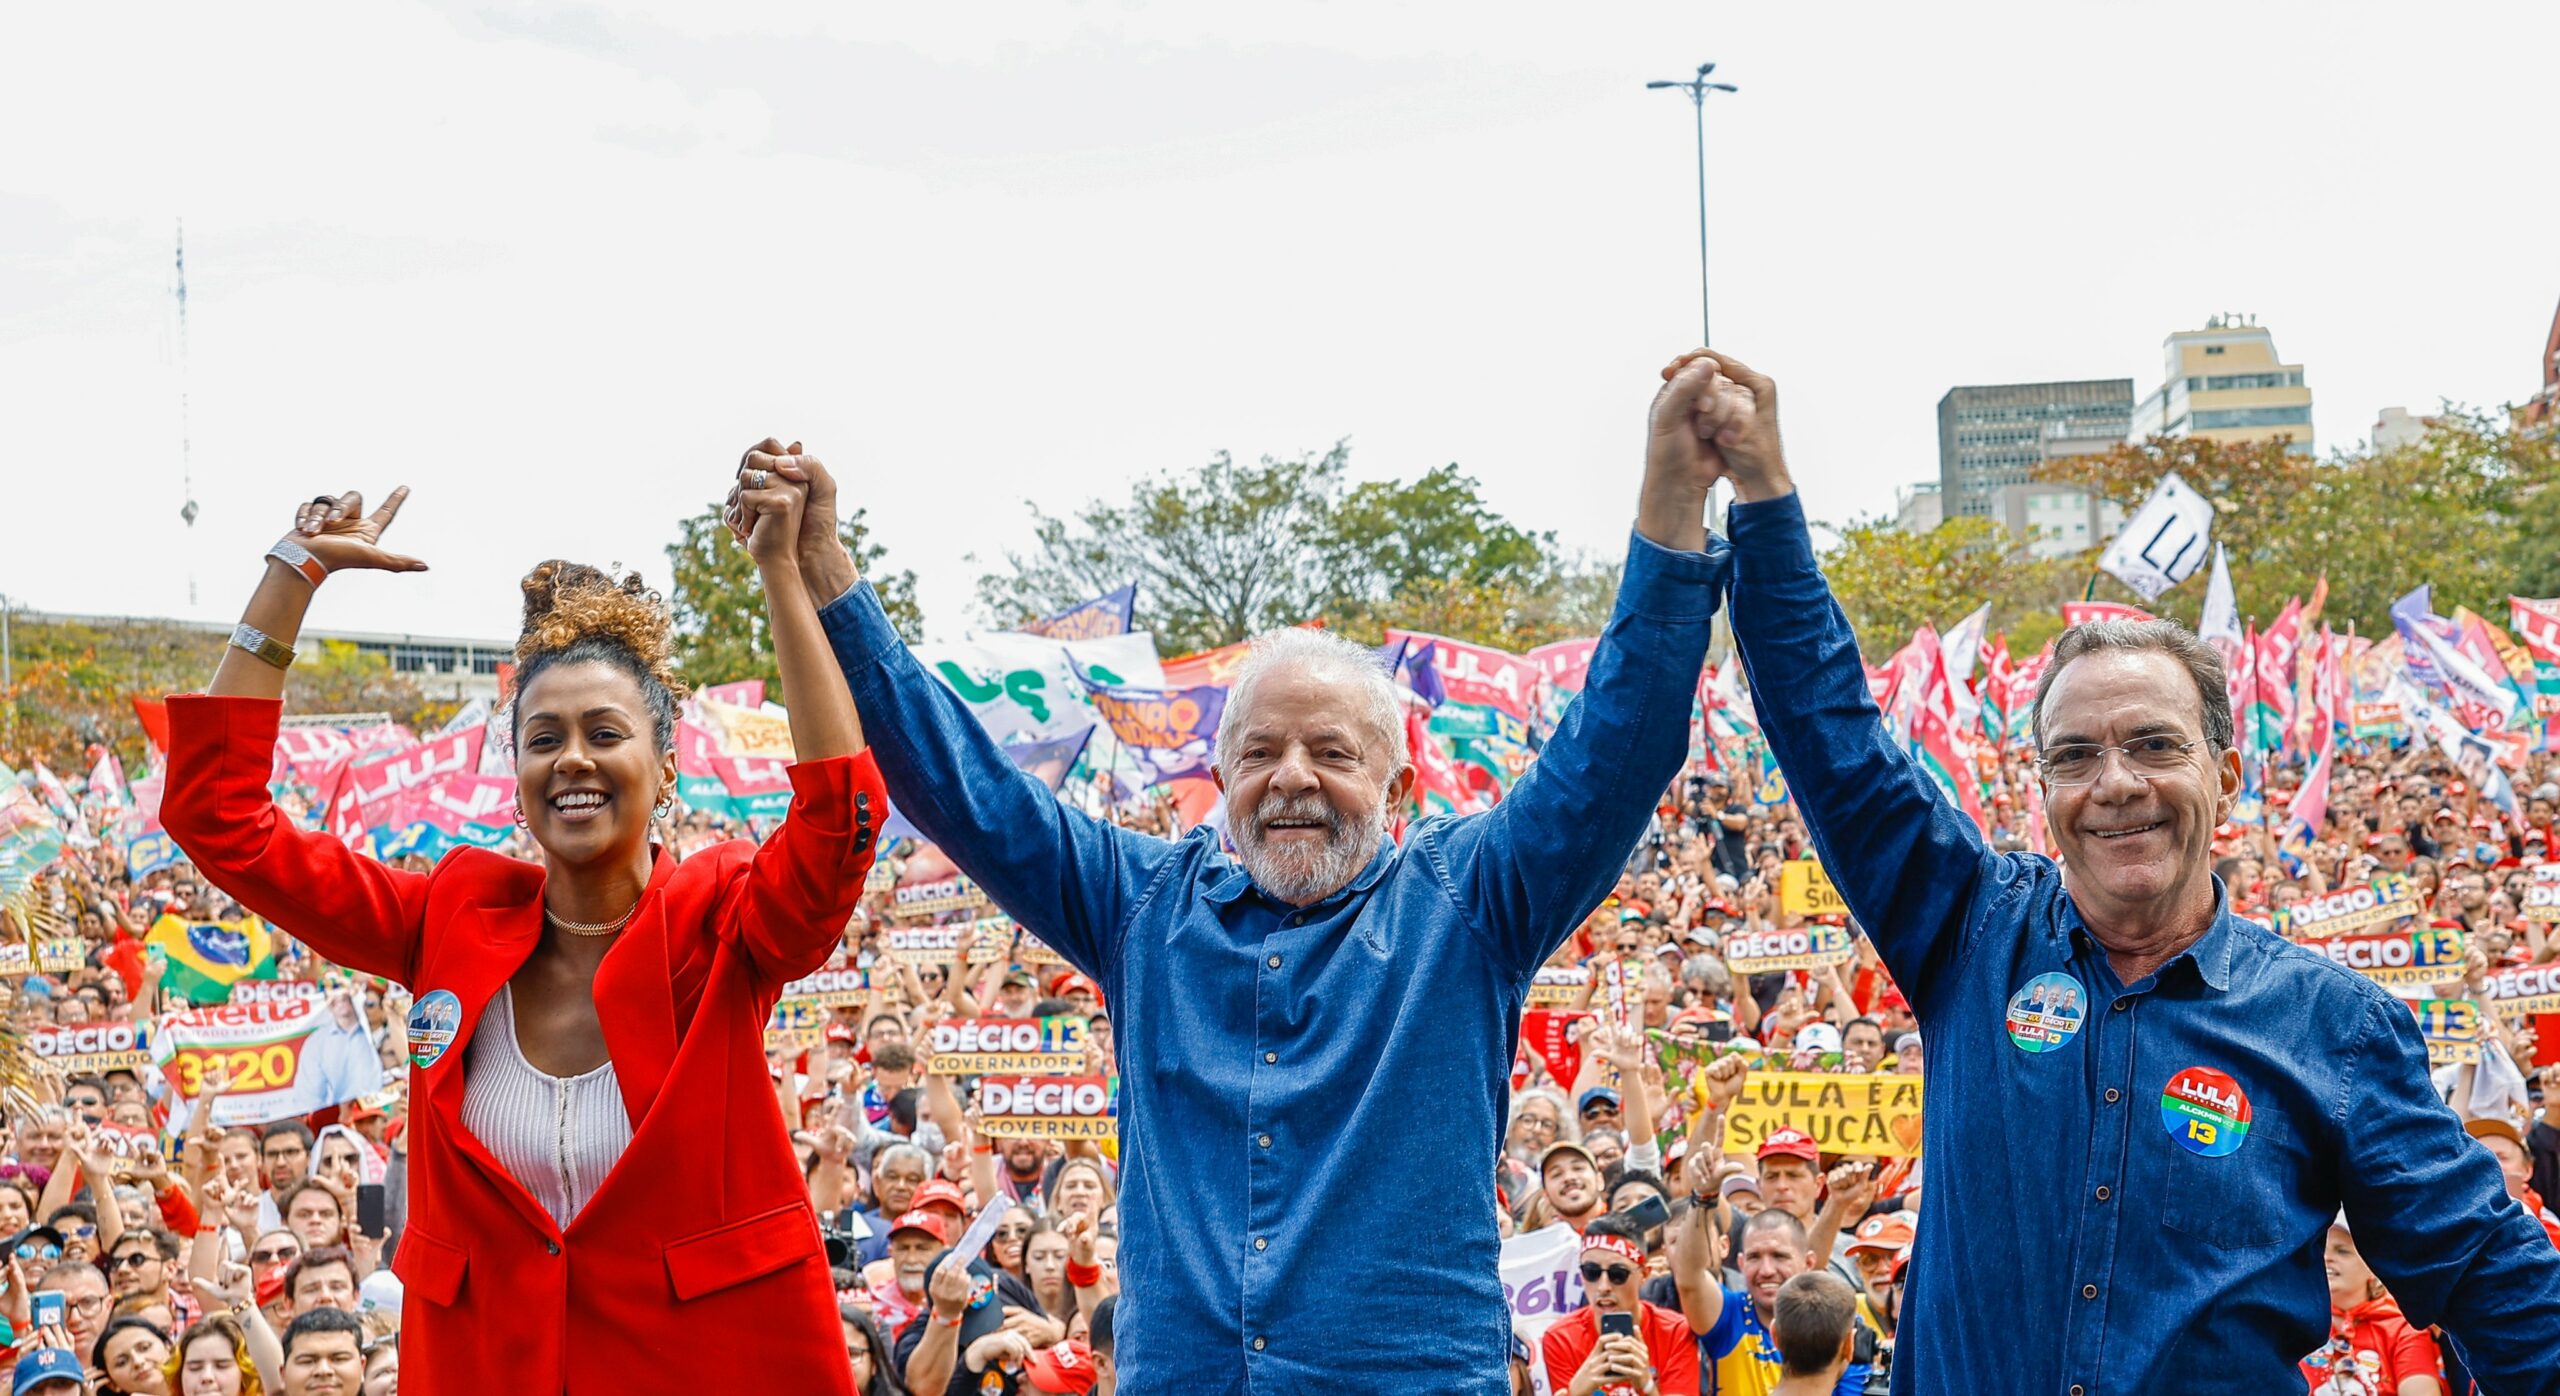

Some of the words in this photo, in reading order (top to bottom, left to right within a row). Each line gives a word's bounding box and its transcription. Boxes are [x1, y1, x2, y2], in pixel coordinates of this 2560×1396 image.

[2290, 887, 2375, 927] DÉCIO
[2377, 873, 2413, 906] 13
[1728, 932, 1809, 959] DÉCIO
[1815, 928, 1845, 951] 13
[2419, 931, 2465, 965] 13
[236, 979, 316, 1004] DÉCIO
[784, 1000, 816, 1028] 13
[2427, 1000, 2477, 1040] 13
[32, 1025, 134, 1057] DÉCIO
[933, 1018, 1040, 1053] DÉCIO
[1048, 1018, 1087, 1052] 13
[2018, 1024, 2045, 1037] LULA
[2046, 1032, 2062, 1044] 13
[933, 1056, 1070, 1071] GOVERNADOR
[981, 1077, 1106, 1116] DÉCIO
[1735, 1081, 1846, 1109] LULA
[1890, 1083, 1919, 1108] A
[2181, 1077, 2239, 1113] LULA
[2178, 1103, 2223, 1124] ALCKMIN
[2187, 1118, 2218, 1145] 13
